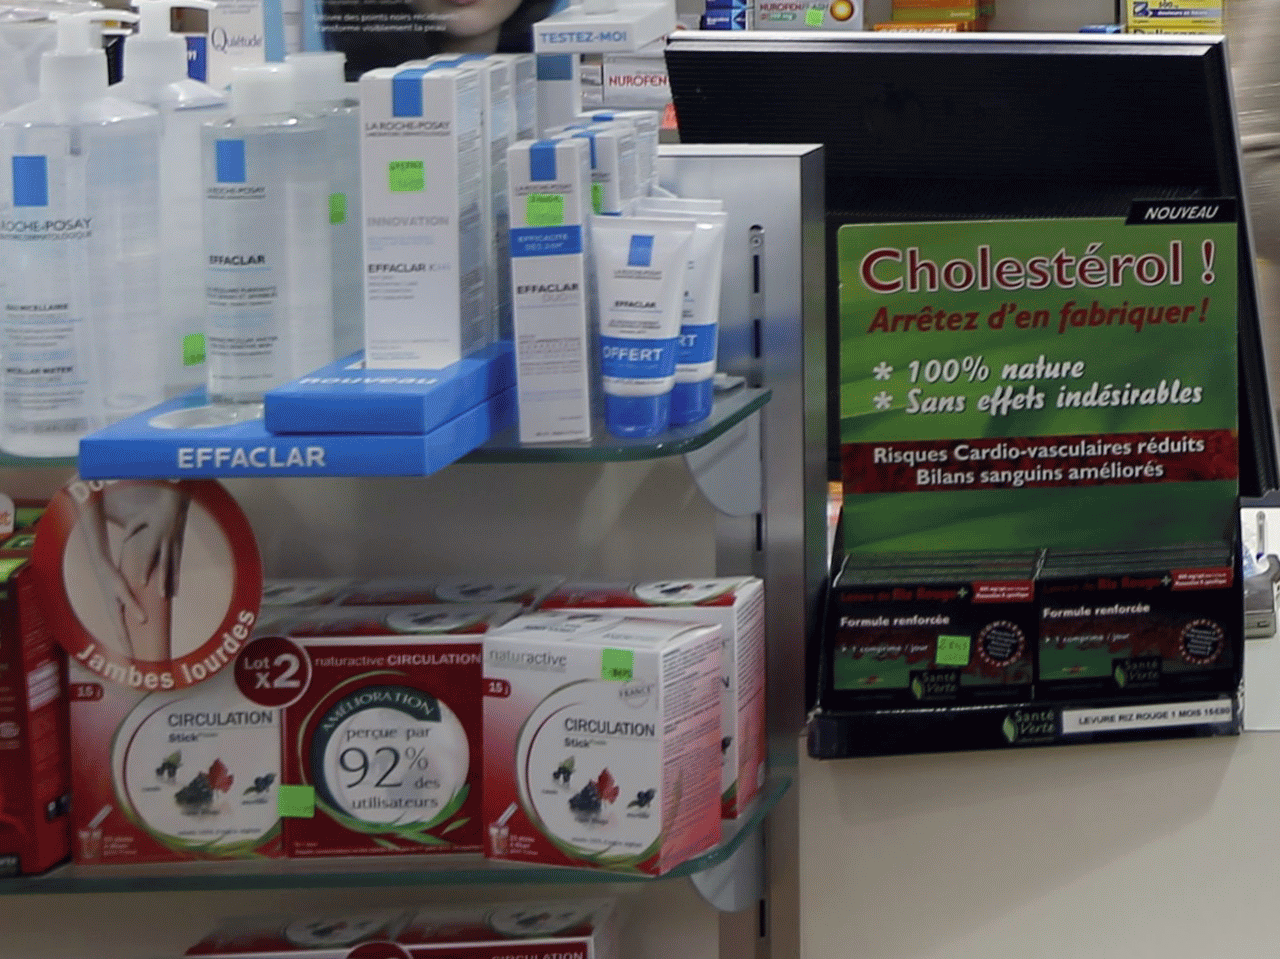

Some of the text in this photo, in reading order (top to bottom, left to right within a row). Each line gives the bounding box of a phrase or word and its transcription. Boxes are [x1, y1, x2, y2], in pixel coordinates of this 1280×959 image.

[540, 30, 628, 44] TESTEZ-MOI
[609, 74, 667, 88] NUROFEN
[1144, 206, 1219, 219] NOUVEAU
[209, 254, 266, 265] EFFACLAR
[860, 241, 1183, 293] Cholestérol
[517, 284, 579, 295] EFFACLAR
[867, 306, 979, 333] Arrêtez
[987, 303, 1049, 329] d'en
[1059, 301, 1194, 334] fabriquer
[602, 347, 663, 364] OFFERT
[908, 356, 1084, 383] 100% nature
[906, 380, 1203, 416] Sans effets indésirables
[177, 446, 325, 468] EFFACLAR
[874, 436, 1205, 466] Risques Cardio-vasculaires réduits
[916, 460, 1164, 487] Bilans sanguins améliorés
[840, 614, 949, 628] Formule renforcée
[76, 609, 254, 692] Jambes lourdes
[243, 656, 269, 672] Lot
[315, 653, 481, 668] naturactive CIRCULATION
[168, 710, 273, 728] CIRCULATION
[564, 718, 654, 735] CIRCULATION
[346, 724, 431, 743] perçue par
[339, 746, 428, 790] 92 %
[414, 775, 440, 789] des
[352, 794, 438, 809] utilisateurs
